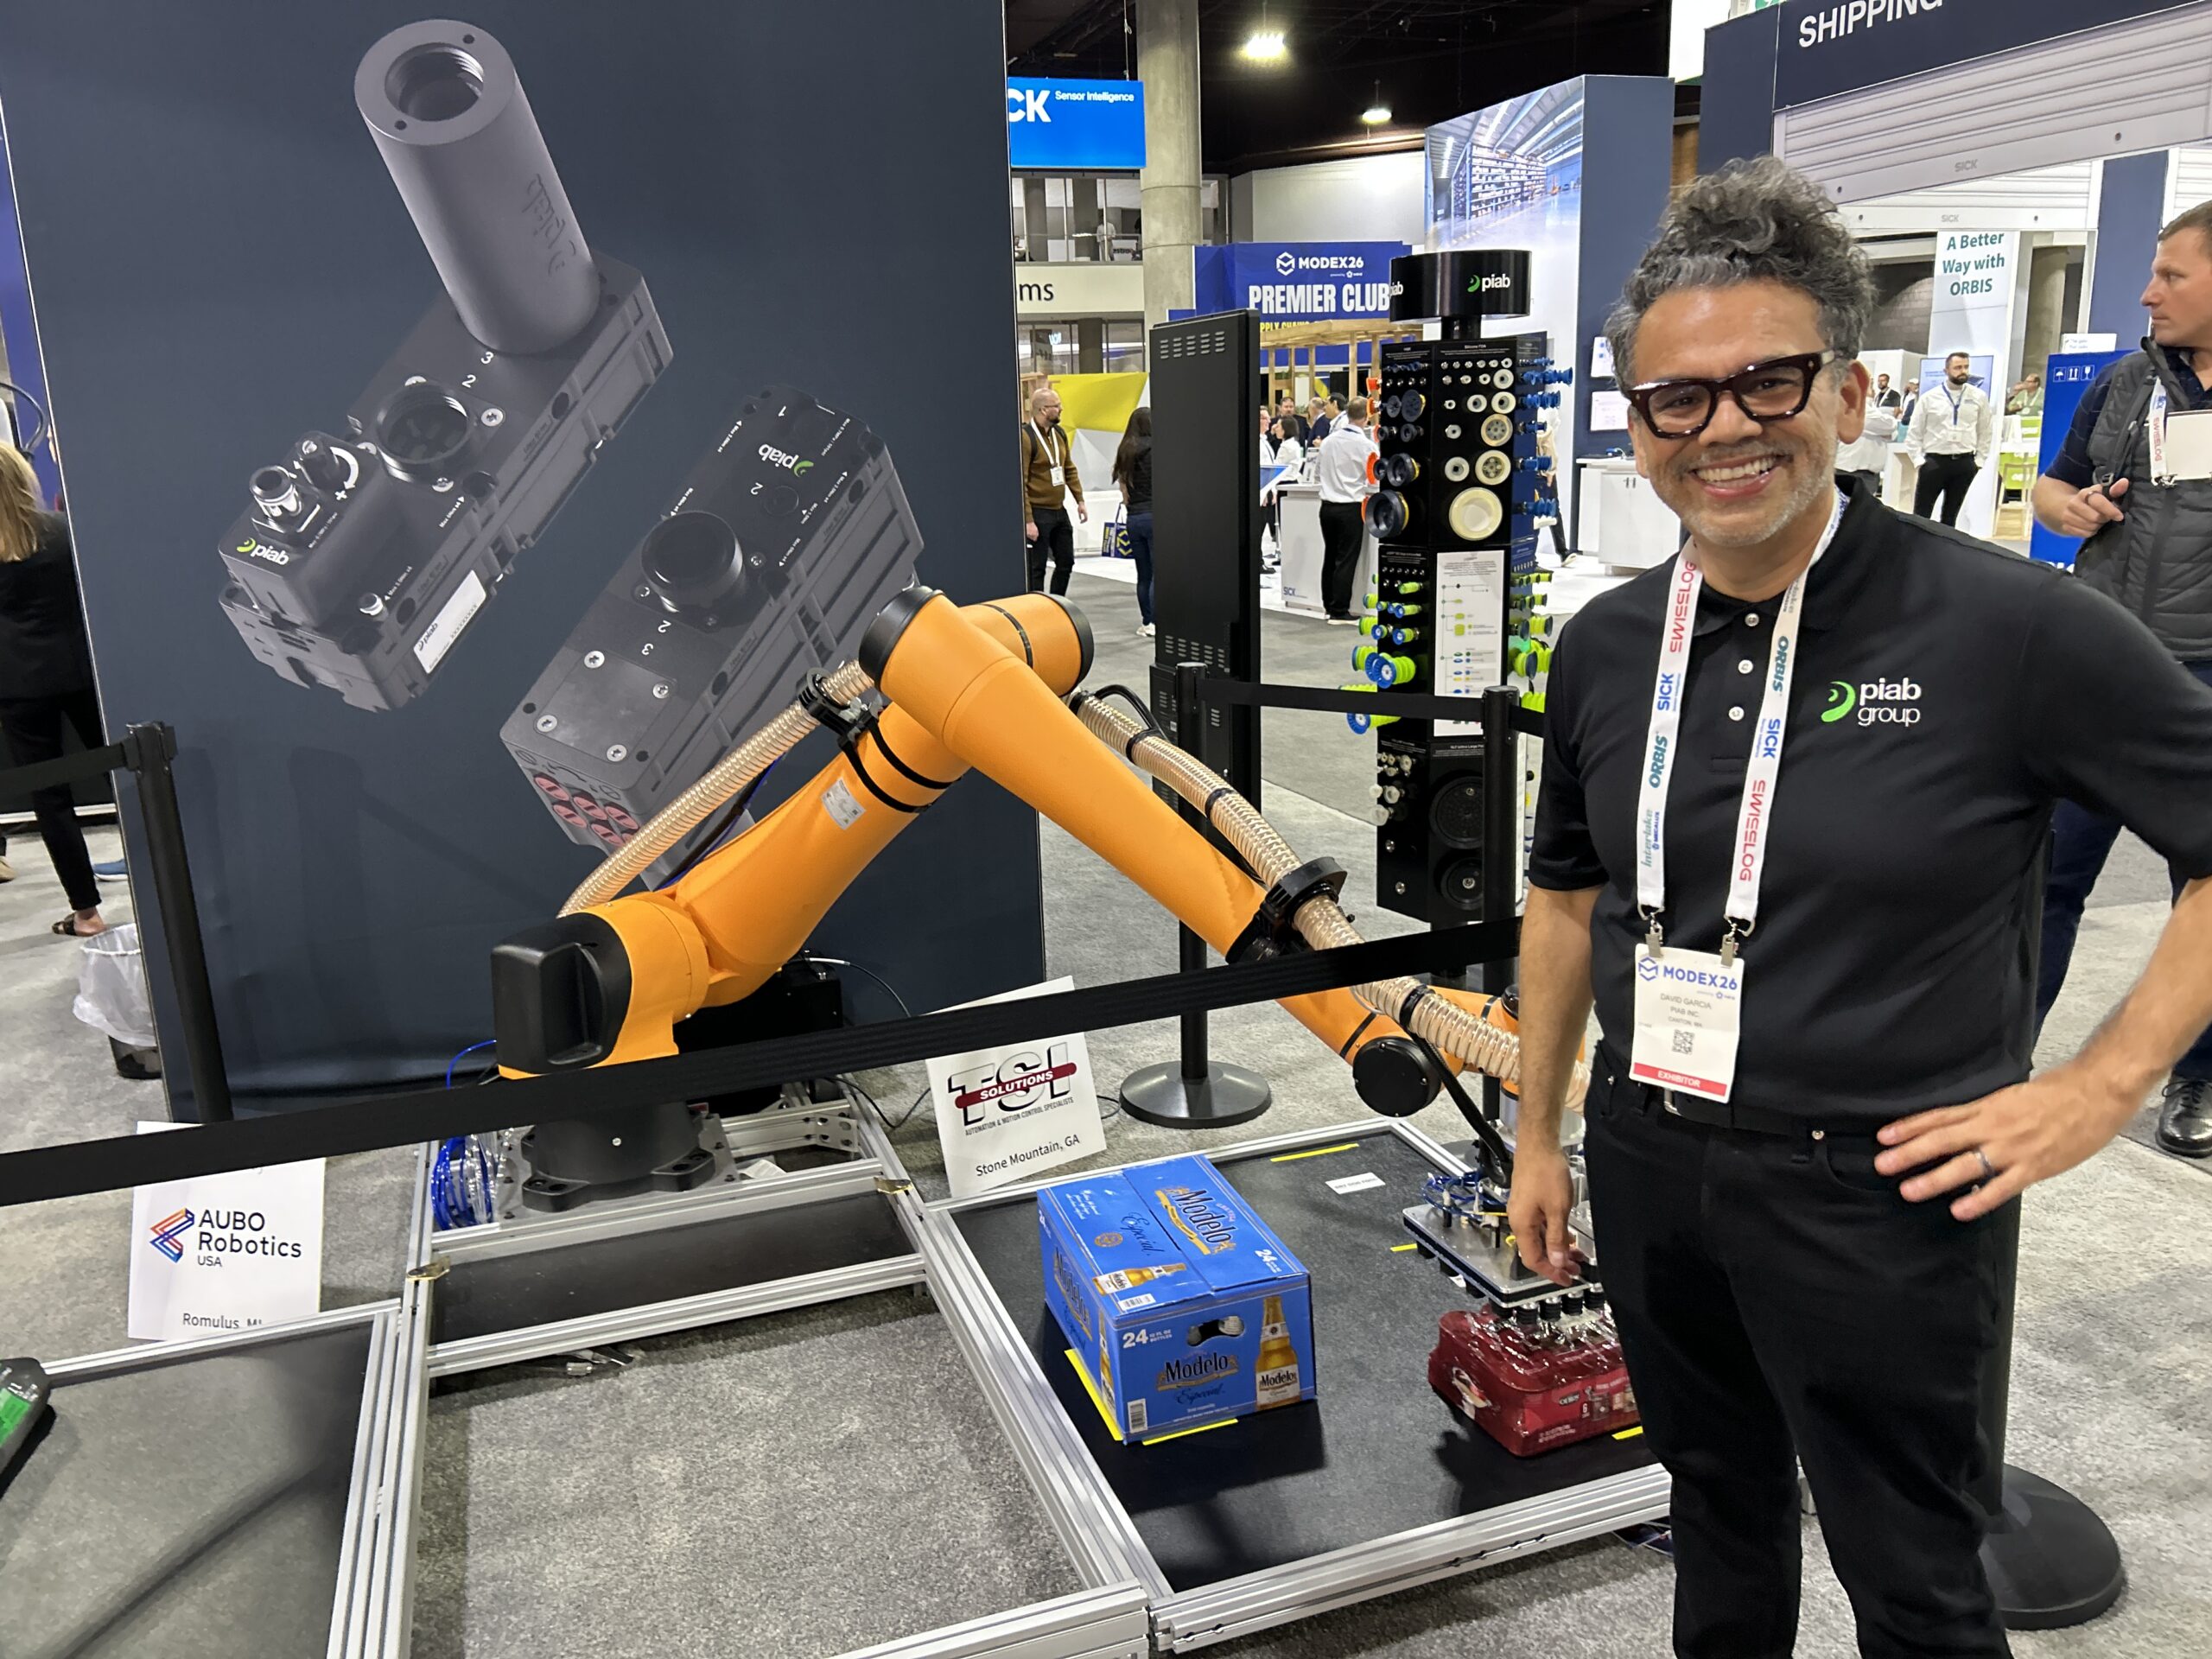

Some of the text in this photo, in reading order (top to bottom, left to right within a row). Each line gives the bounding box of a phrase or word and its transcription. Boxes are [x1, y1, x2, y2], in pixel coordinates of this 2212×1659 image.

[1055, 90, 1085, 101] Sensor
[1087, 91, 1135, 104] Intelligence
[1955, 159, 1979, 172] SICK
[1941, 214, 1960, 223] SICK
[1947, 232, 2005, 251] A Better
[1298, 257, 1364, 270] MODEX26
[1942, 253, 2005, 276] Way with
[1019, 283, 1054, 302] ms
[1481, 273, 1511, 292] piab
[1949, 278, 1993, 296] ORBIS
[1249, 283, 1390, 315] PREMIER CLUB
[480, 351, 494, 364] 3
[461, 374, 476, 388] 2
[778, 405, 787, 417] 1
[758, 443, 799, 469] piab
[750, 482, 764, 495] 2
[251, 544, 289, 566] piab
[1669, 562, 1697, 653] SWISSLOG
[658, 620, 671, 633] 2
[641, 643, 654, 656] 3
[1773, 635, 1789, 692] ORBIS
[1656, 673, 1674, 711] SICK
[1859, 677, 1922, 706] piab
[1858, 707, 1921, 727] group
[1763, 718, 1781, 759] SICK
[1649, 734, 1669, 788] ORBIS
[1739, 779, 1766, 882] SWISSLOG
[1663, 965, 1738, 990] MODEX26
[1660, 993, 1682, 1004] DAVID
[948, 1041, 1071, 1127] TSI
[980, 1071, 1053, 1100] SOLUTIONS
[1657, 1070, 1701, 1088] EXHIBITOR
[965, 1122, 995, 1136] AUTOMATION
[1044, 1096, 1074, 1110] SPECIALISTS
[976, 1134, 1080, 1176] Stone Mountain, GA
[199, 1209, 265, 1232] AUBO
[1173, 1189, 1236, 1243] Modelo
[1120, 1211, 1165, 1254] Especial
[198, 1231, 302, 1258] Robotics
[197, 1255, 223, 1268] USA
[1255, 1249, 1278, 1263] 24
[182, 1313, 240, 1329] Romulus
[1122, 1329, 1149, 1349] 24
[1165, 1351, 1228, 1382] Modelo
[1261, 1370, 1294, 1387] Modelo
